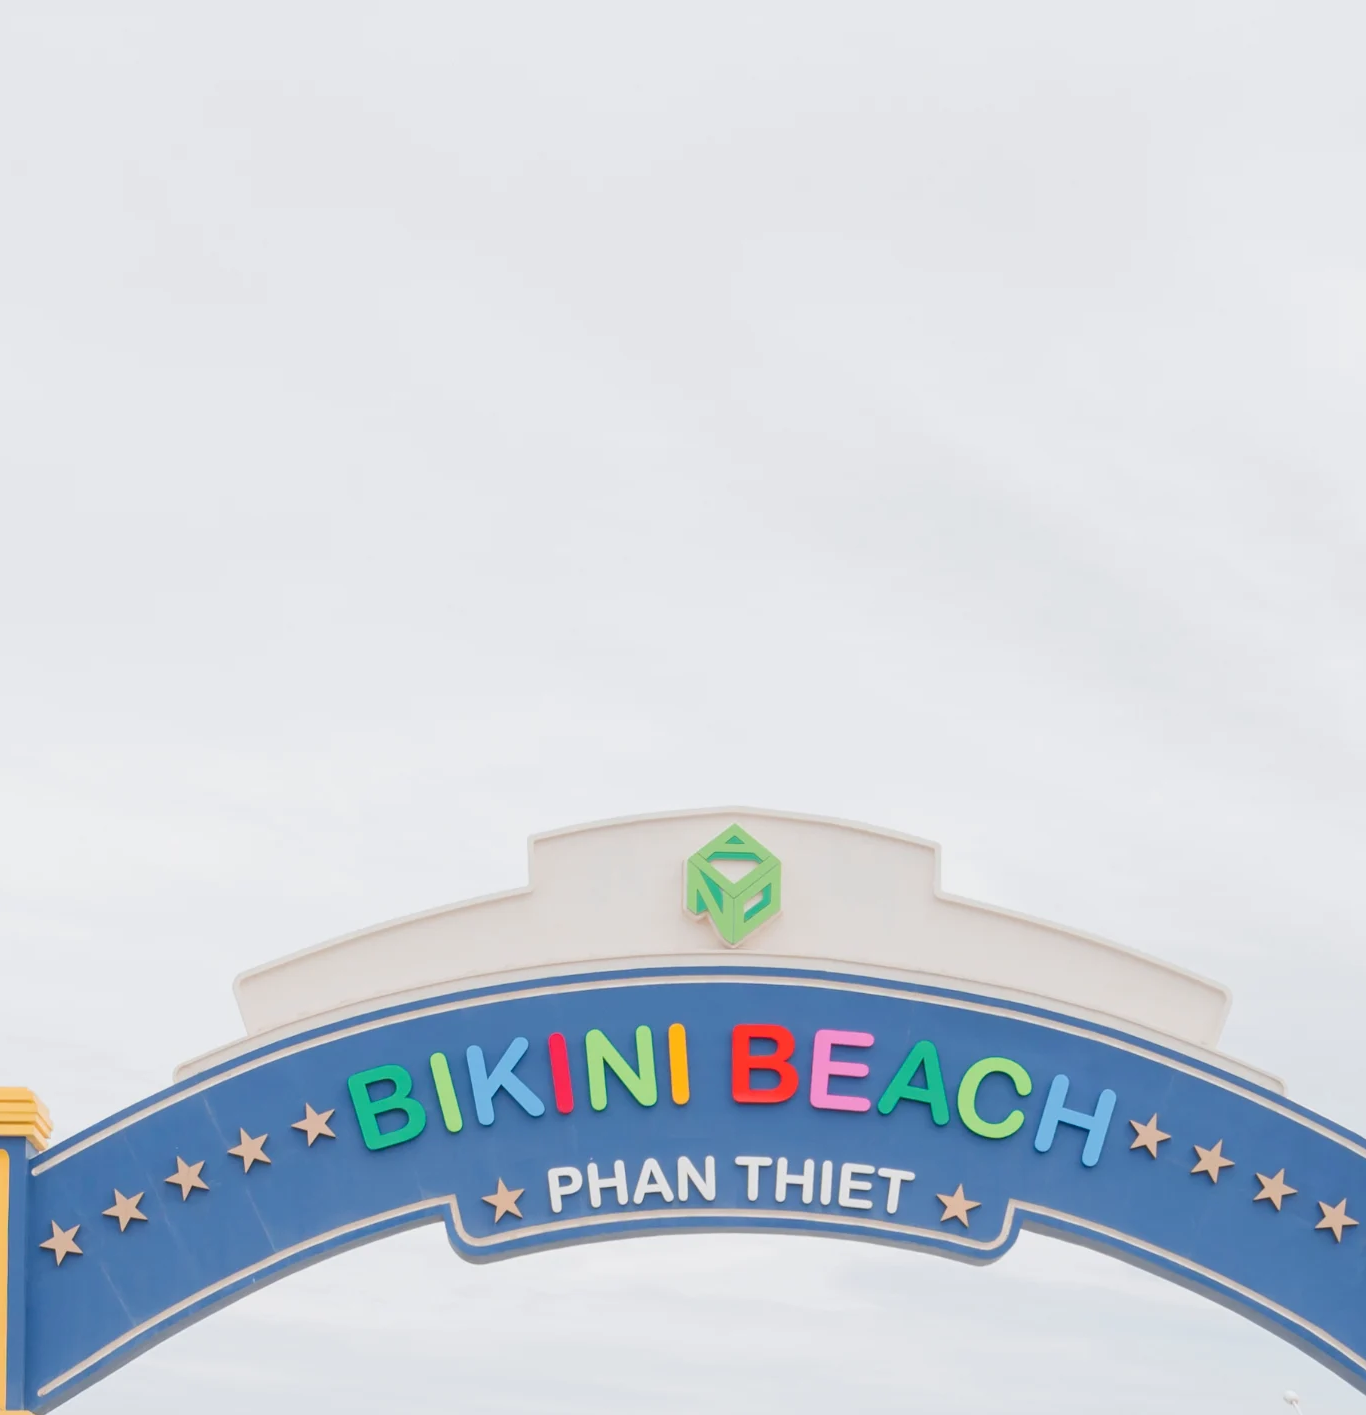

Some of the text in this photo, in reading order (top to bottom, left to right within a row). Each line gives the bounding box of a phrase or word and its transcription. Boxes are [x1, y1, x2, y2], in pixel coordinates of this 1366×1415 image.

[346, 1022, 1117, 1168] BIKINI BEACH
[546, 1154, 917, 1215] PHAN THIET
